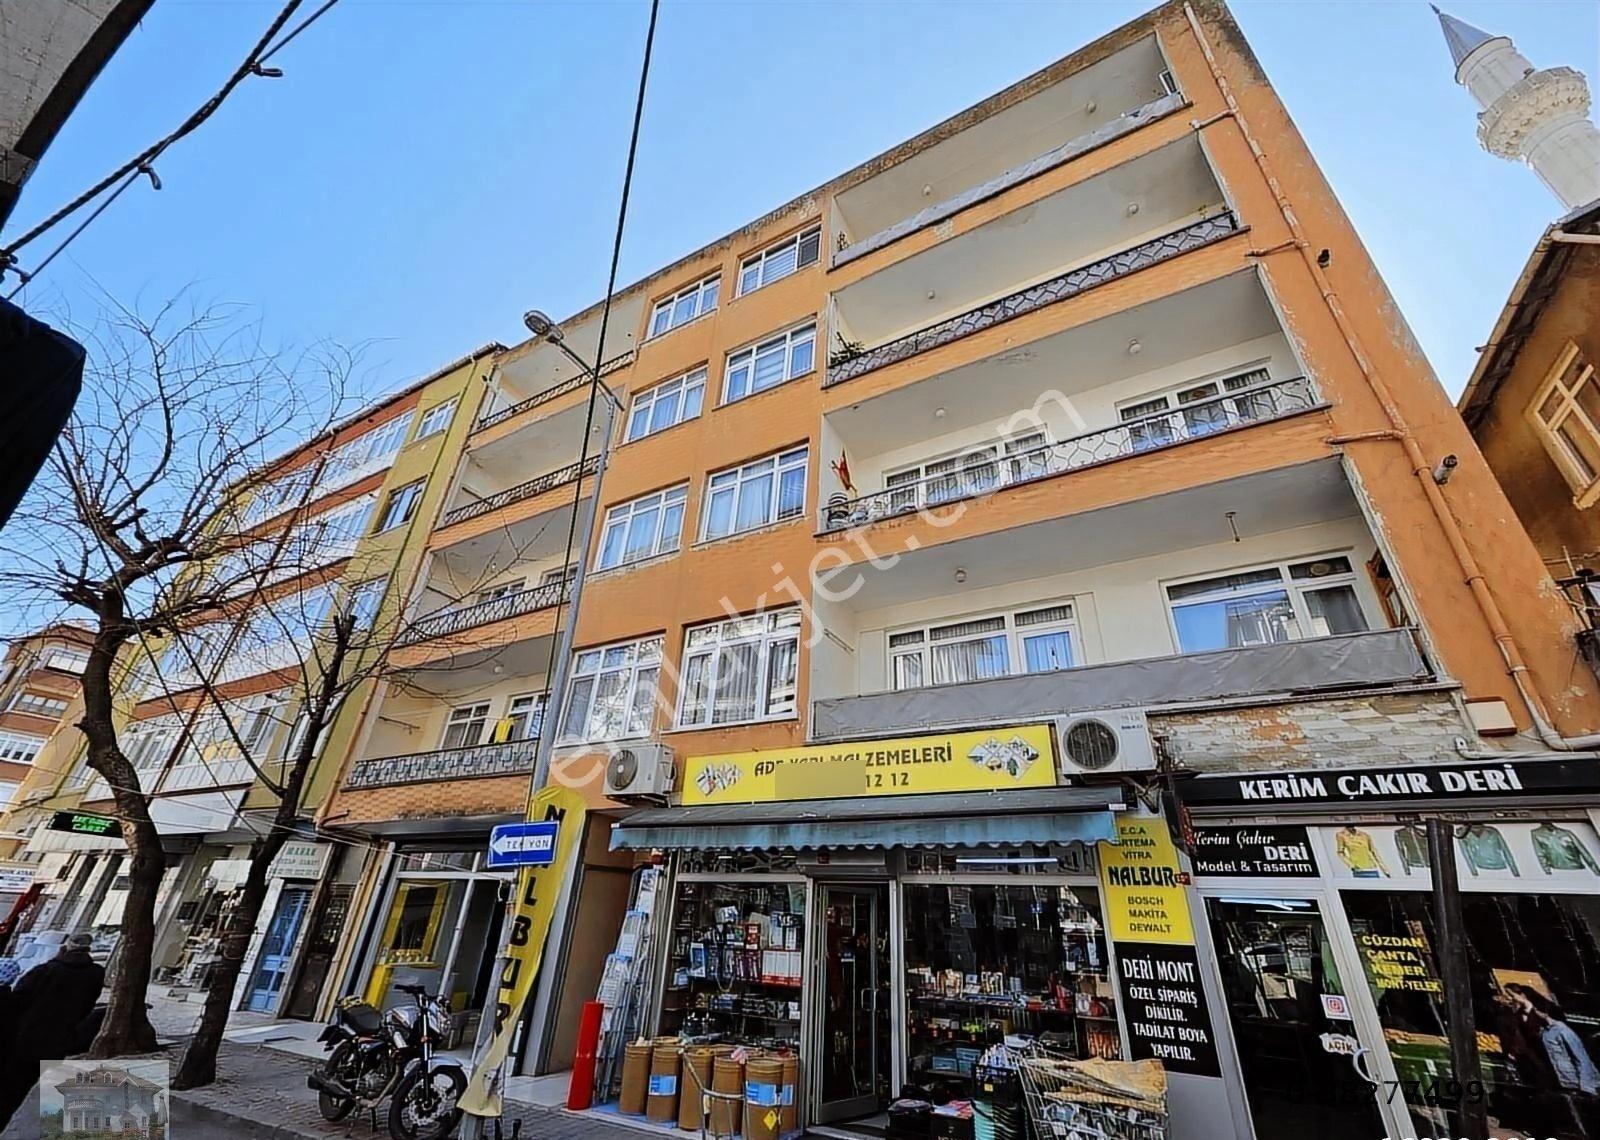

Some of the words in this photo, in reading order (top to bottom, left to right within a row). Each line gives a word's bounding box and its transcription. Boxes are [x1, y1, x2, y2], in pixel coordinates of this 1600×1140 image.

[891, 772, 909, 787] 12
[1239, 774, 1328, 799] KERİM
[1337, 773, 1433, 800] ÇAKIR
[1439, 763, 1523, 791] DERİ
[1263, 842, 1309, 861] DERİ
[1196, 861, 1237, 873] Model
[1240, 861, 1251, 872] &
[1252, 861, 1313, 872] Tasarım
[1107, 866, 1177, 888] NALBUR
[1127, 896, 1164, 906] BOSCH
[494, 804, 567, 1037] NLBUR
[1128, 907, 1168, 919] MAKİTA
[1129, 923, 1172, 933] DEWALT
[1122, 954, 1154, 980] DERİ
[1156, 960, 1195, 983] MONT
[1129, 983, 1156, 1001] ÖZEL
[1157, 985, 1198, 1008] SİPARİŞ
[1145, 1002, 1188, 1022] DİKİLİR.
[1133, 1021, 1175, 1040] TADİLAT
[1178, 1027, 1209, 1044] BOYA
[1150, 1042, 1196, 1061] YAPILIR.
